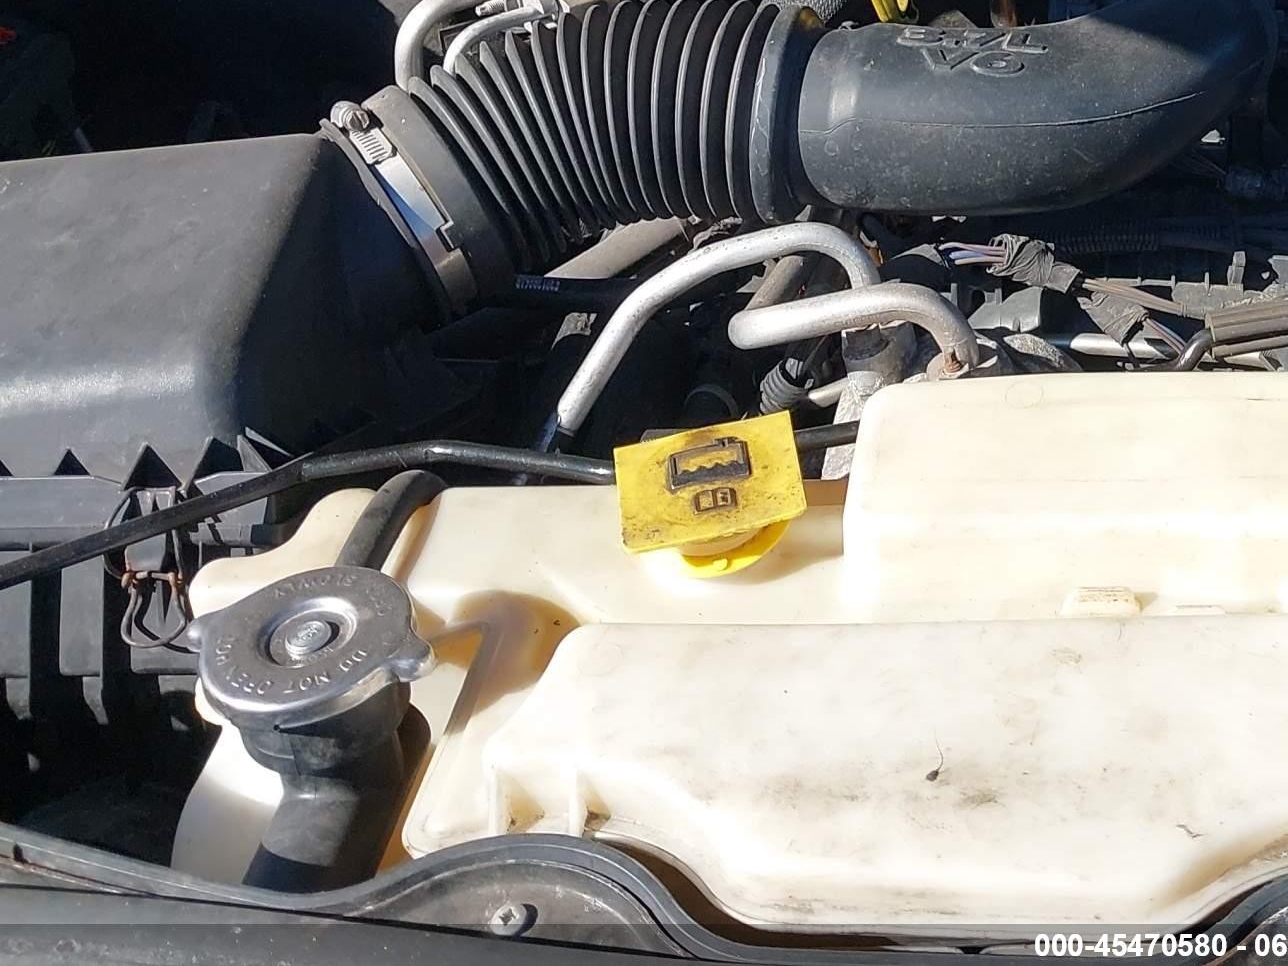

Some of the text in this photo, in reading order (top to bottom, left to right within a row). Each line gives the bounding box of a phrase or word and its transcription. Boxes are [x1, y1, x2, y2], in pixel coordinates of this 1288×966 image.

[919, 48, 1025, 77] V6
[338, 649, 367, 671] DO
[282, 669, 329, 693] NOT
